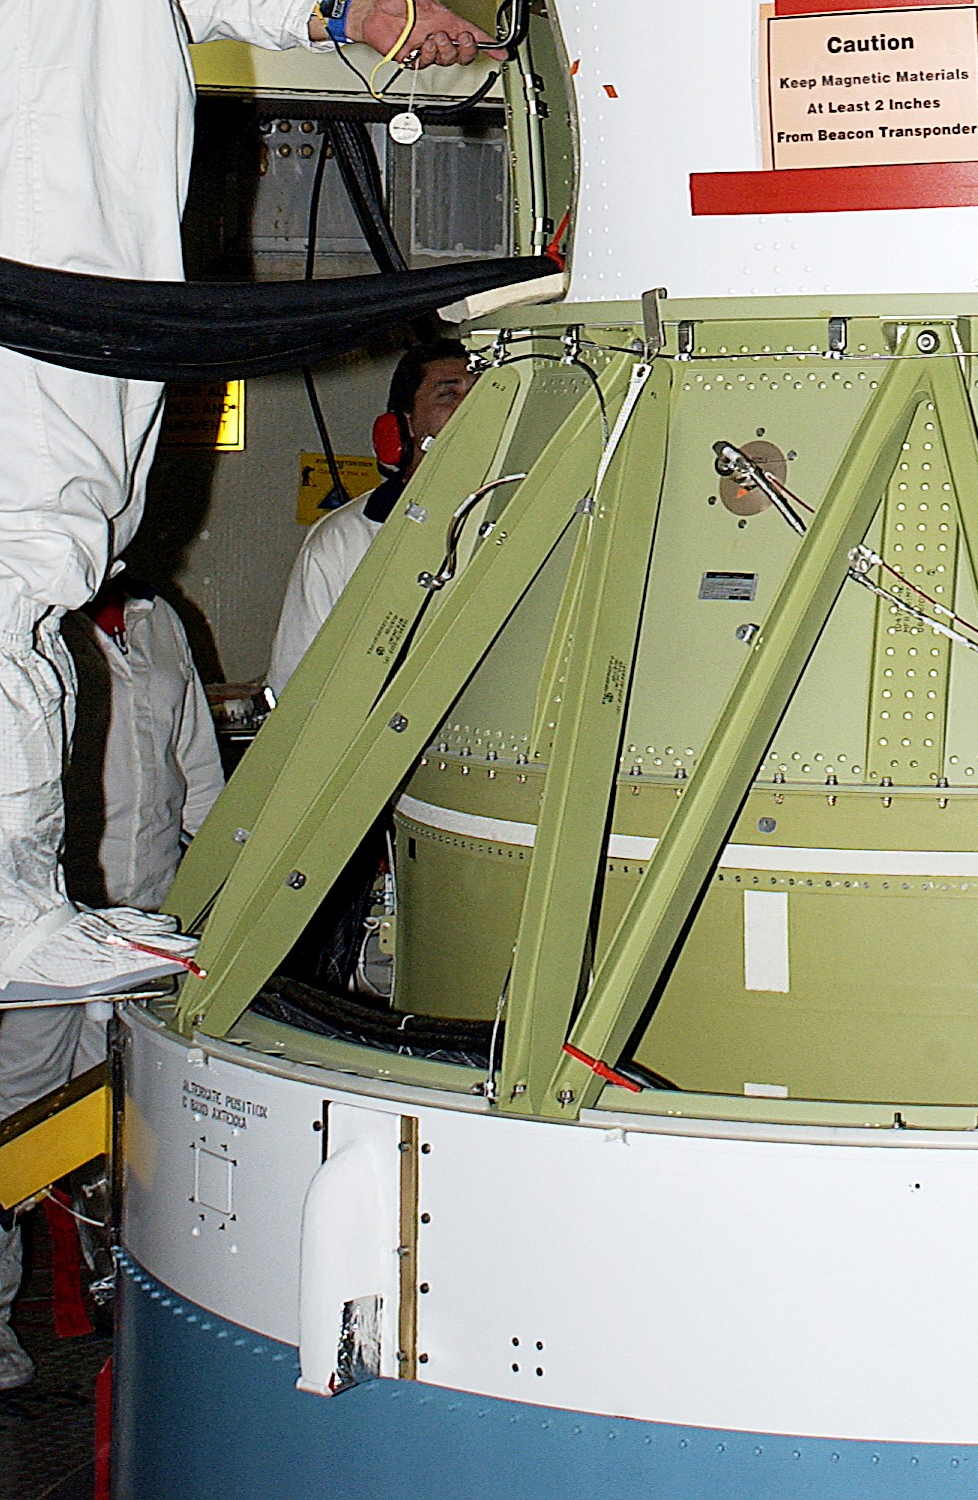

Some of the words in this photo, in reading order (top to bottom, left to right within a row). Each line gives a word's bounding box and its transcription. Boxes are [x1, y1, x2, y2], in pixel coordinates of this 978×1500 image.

[827, 33, 914, 54] Caution
[779, 77, 817, 90] Keep
[821, 71, 891, 87] Magnetic
[896, 68, 969, 82] Materials
[807, 103, 824, 115] At
[828, 100, 870, 114] Least
[875, 99, 885, 111] 2
[889, 97, 941, 111] Inches
[777, 131, 814, 143] From
[818, 128, 874, 141] Beacon
[878, 123, 978, 139] Transponder
